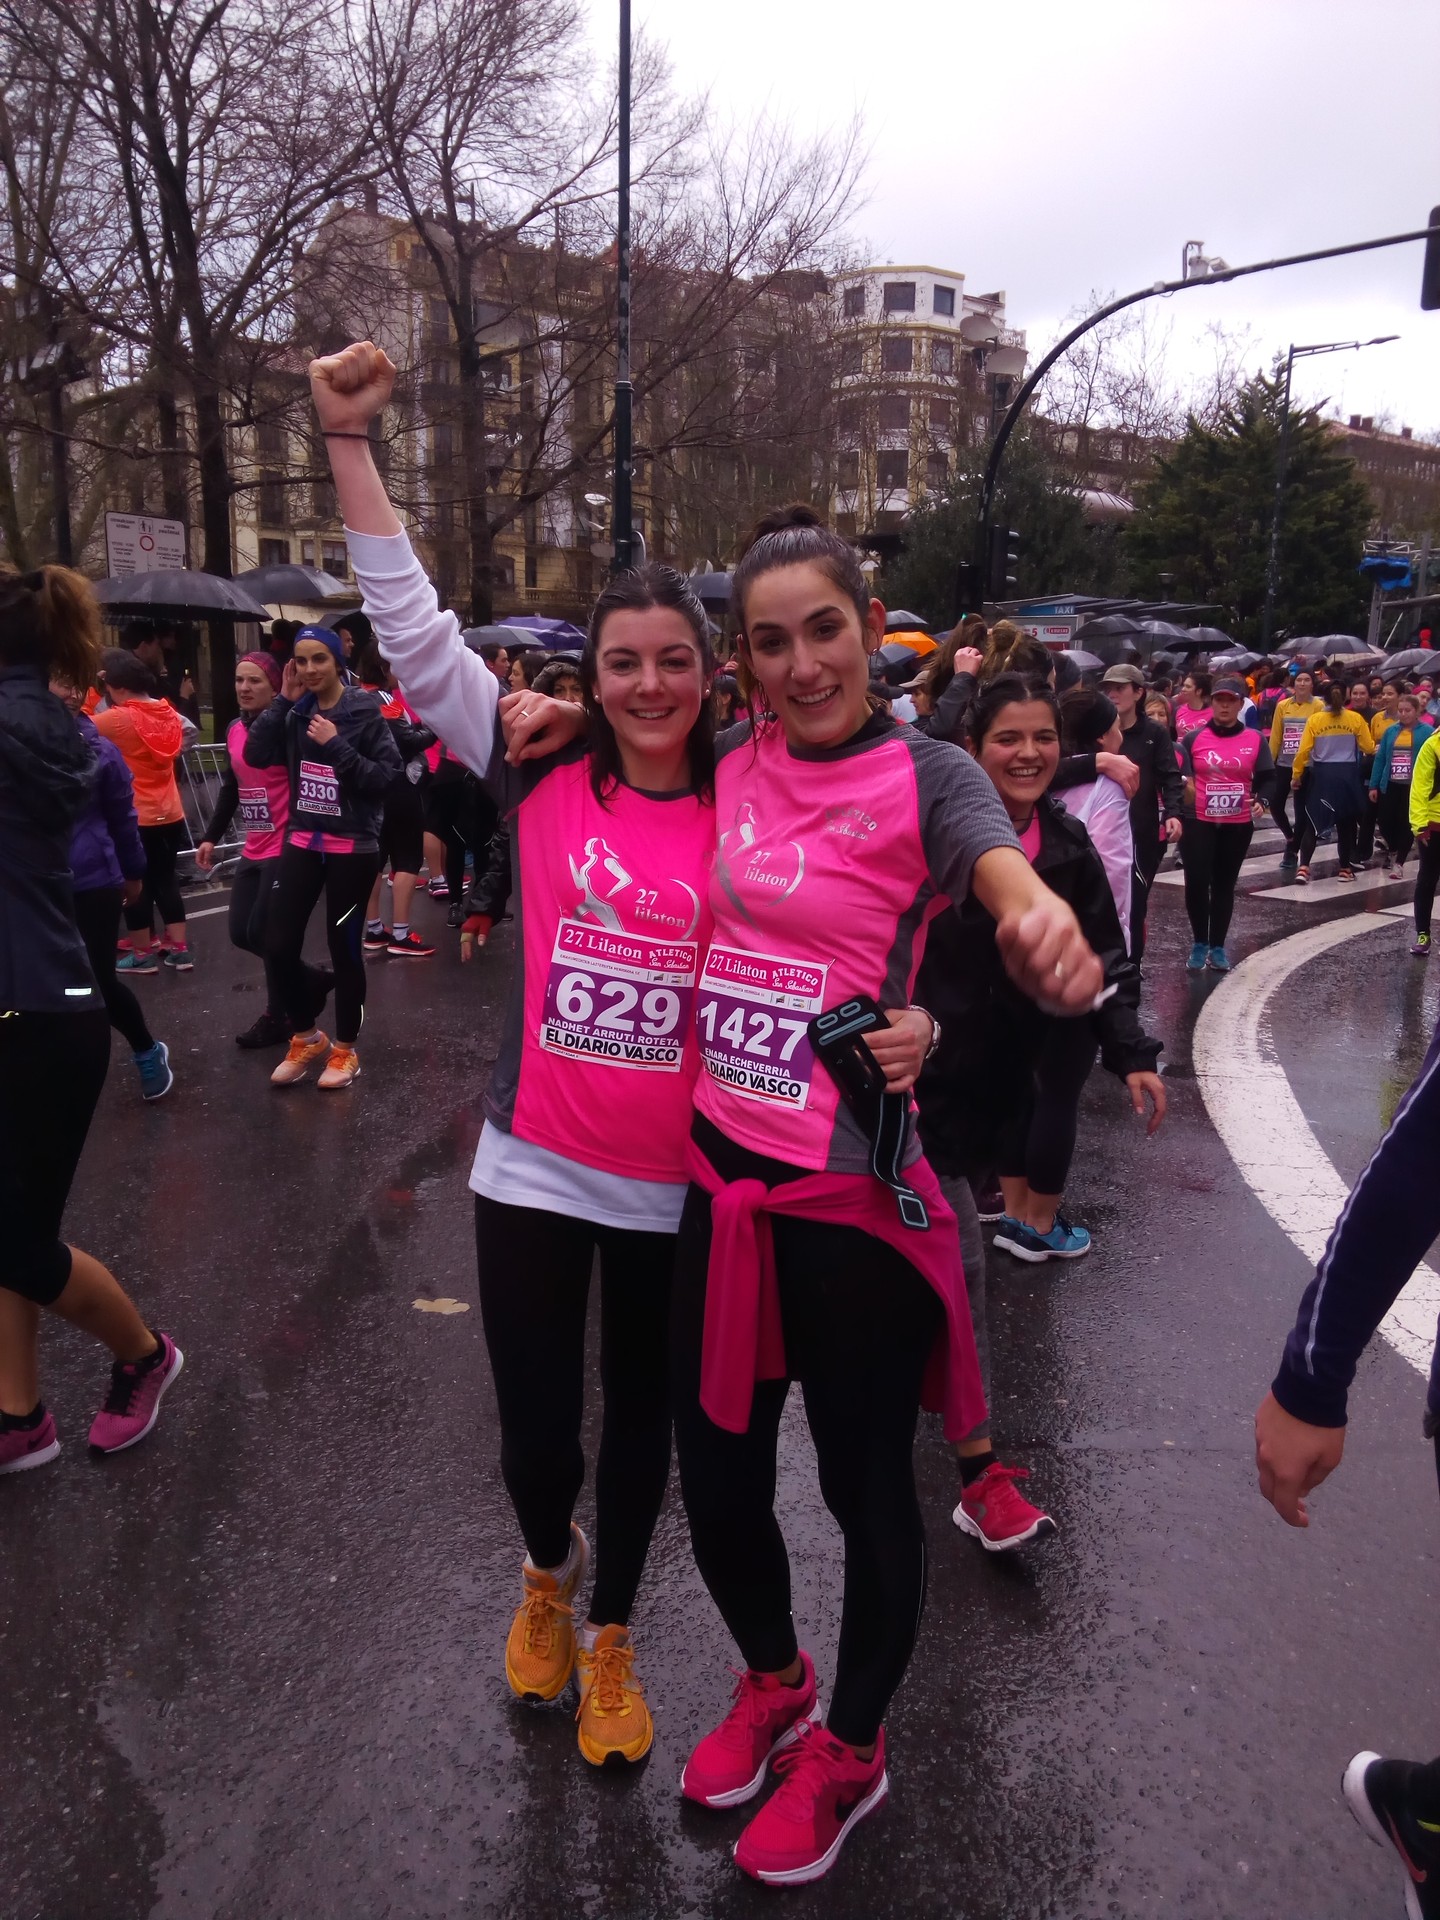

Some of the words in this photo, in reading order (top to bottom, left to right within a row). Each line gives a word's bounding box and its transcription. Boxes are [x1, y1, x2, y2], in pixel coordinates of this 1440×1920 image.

[1054, 606, 1074, 614] TAXI
[1032, 628, 1038, 636] 5
[300, 780, 337, 801] 3330
[1208, 795, 1241, 808] 407
[750, 850, 771, 866] 27
[744, 866, 788, 888] lilaton
[635, 888, 658, 906] 27
[634, 906, 687, 928] lilaton
[586, 934, 642, 960] Lilaton
[648, 948, 692, 962] ATLETICO
[648, 958, 662, 968] San
[663, 959, 690, 969] Sebastian
[724, 957, 767, 981] Lilaton
[772, 967, 819, 986] ATLETICO
[772, 977, 783, 988] San
[784, 979, 814, 994] Sebastian
[556, 971, 680, 1036] 629
[547, 1016, 591, 1034] NADHET
[592, 1028, 635, 1043] ARRUTI
[637, 1035, 680, 1047] ROTETA
[700, 1000, 809, 1062] 1427
[545, 1027, 562, 1044] EL
[563, 1032, 621, 1057] DIARIO
[623, 1044, 678, 1062] VASCO
[705, 1047, 729, 1063] ENARA
[729, 1055, 791, 1078] ECHEVERRIA
[710, 1061, 747, 1086] DIARIO
[749, 1072, 801, 1098] VASCO
